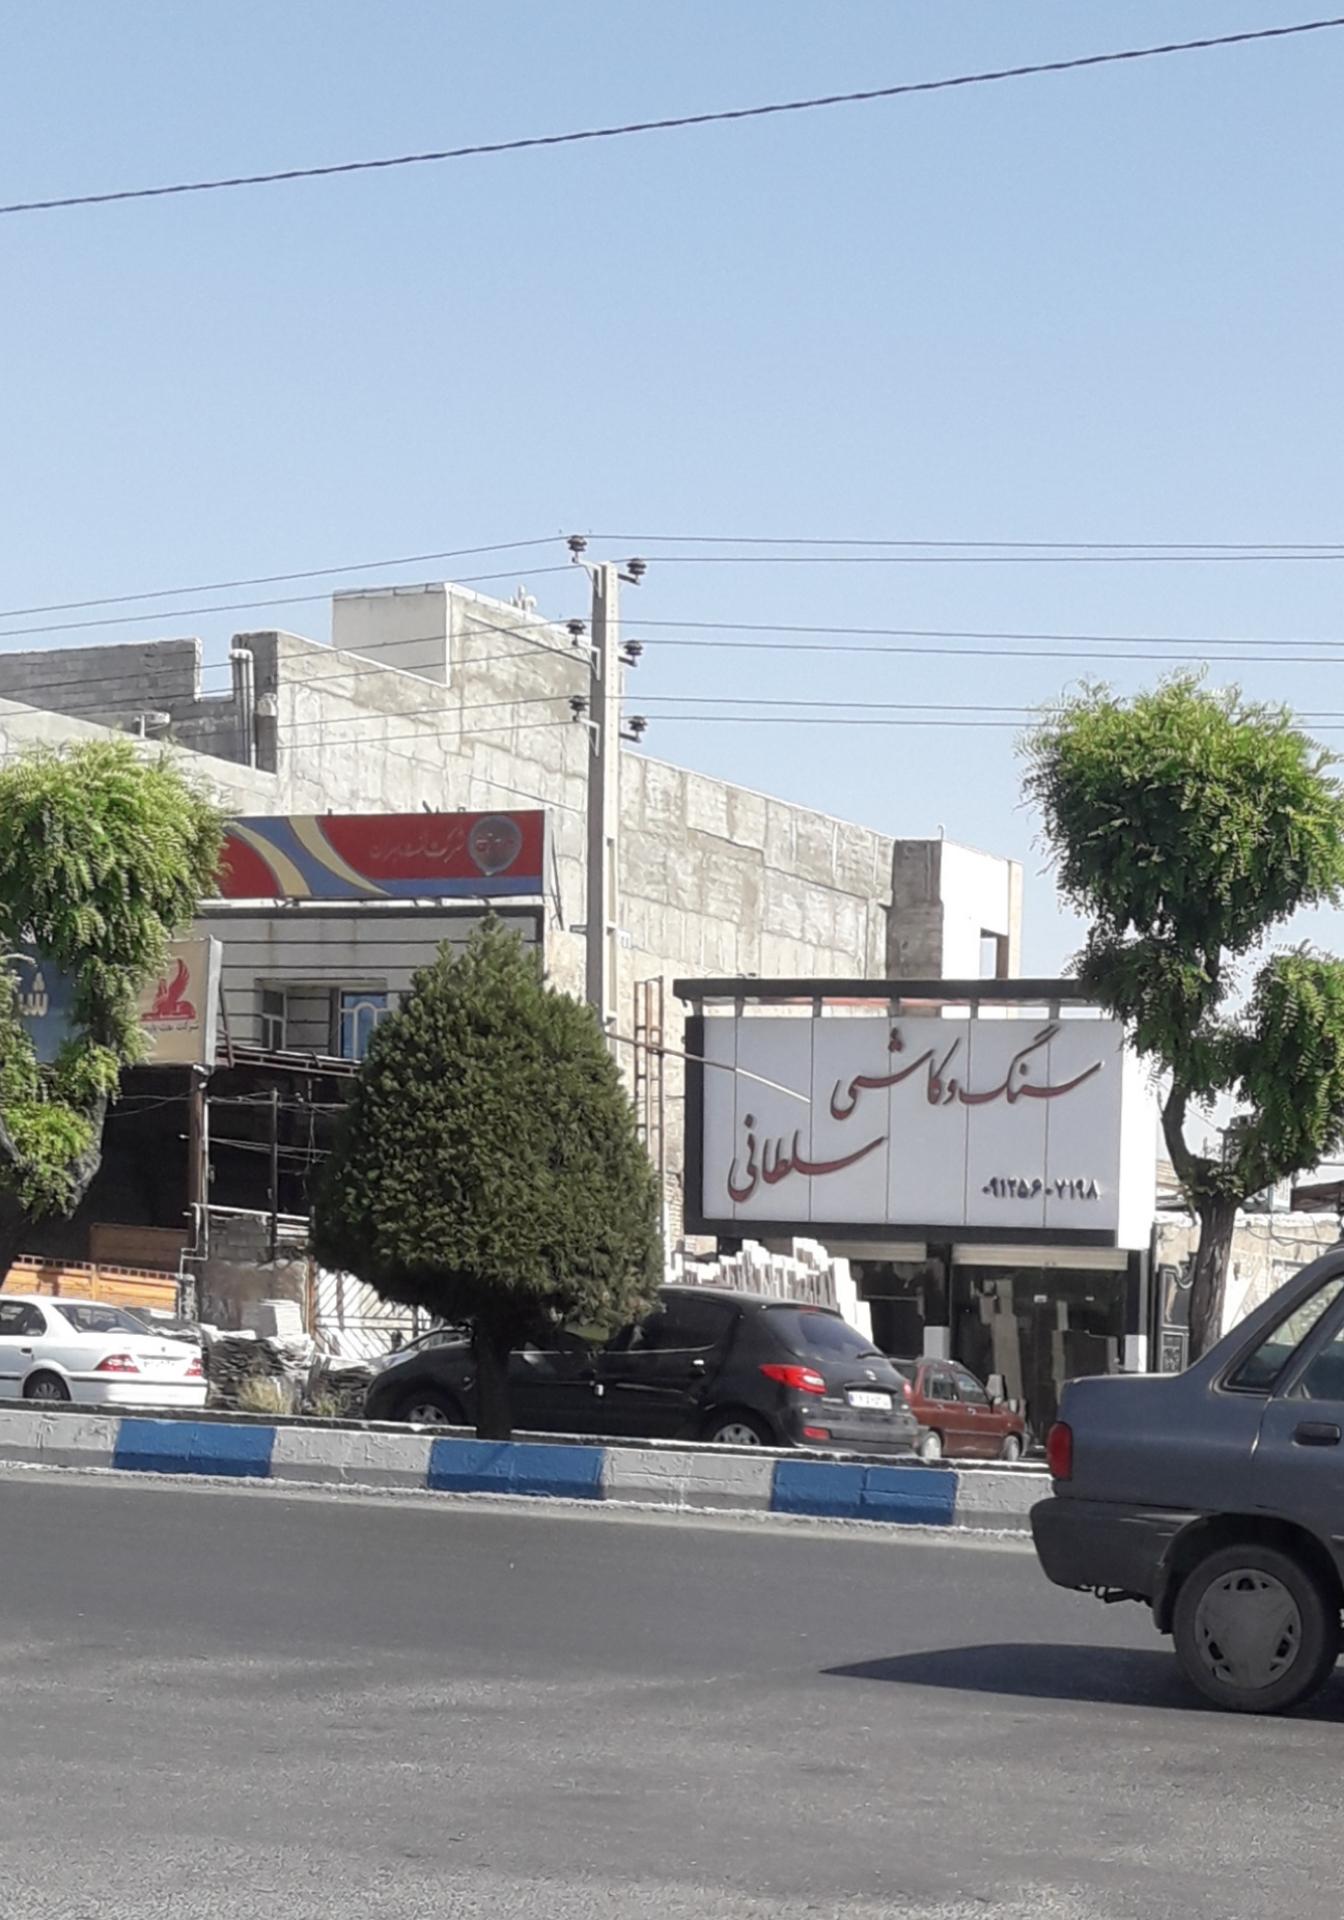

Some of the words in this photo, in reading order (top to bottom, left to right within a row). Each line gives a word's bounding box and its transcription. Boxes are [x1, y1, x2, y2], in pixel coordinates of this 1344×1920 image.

[830, 1027, 960, 1121] کاشی
[942, 1078, 959, 1106] و
[958, 1024, 1105, 1105] سنگ
[727, 1113, 886, 1203] سلطانی
